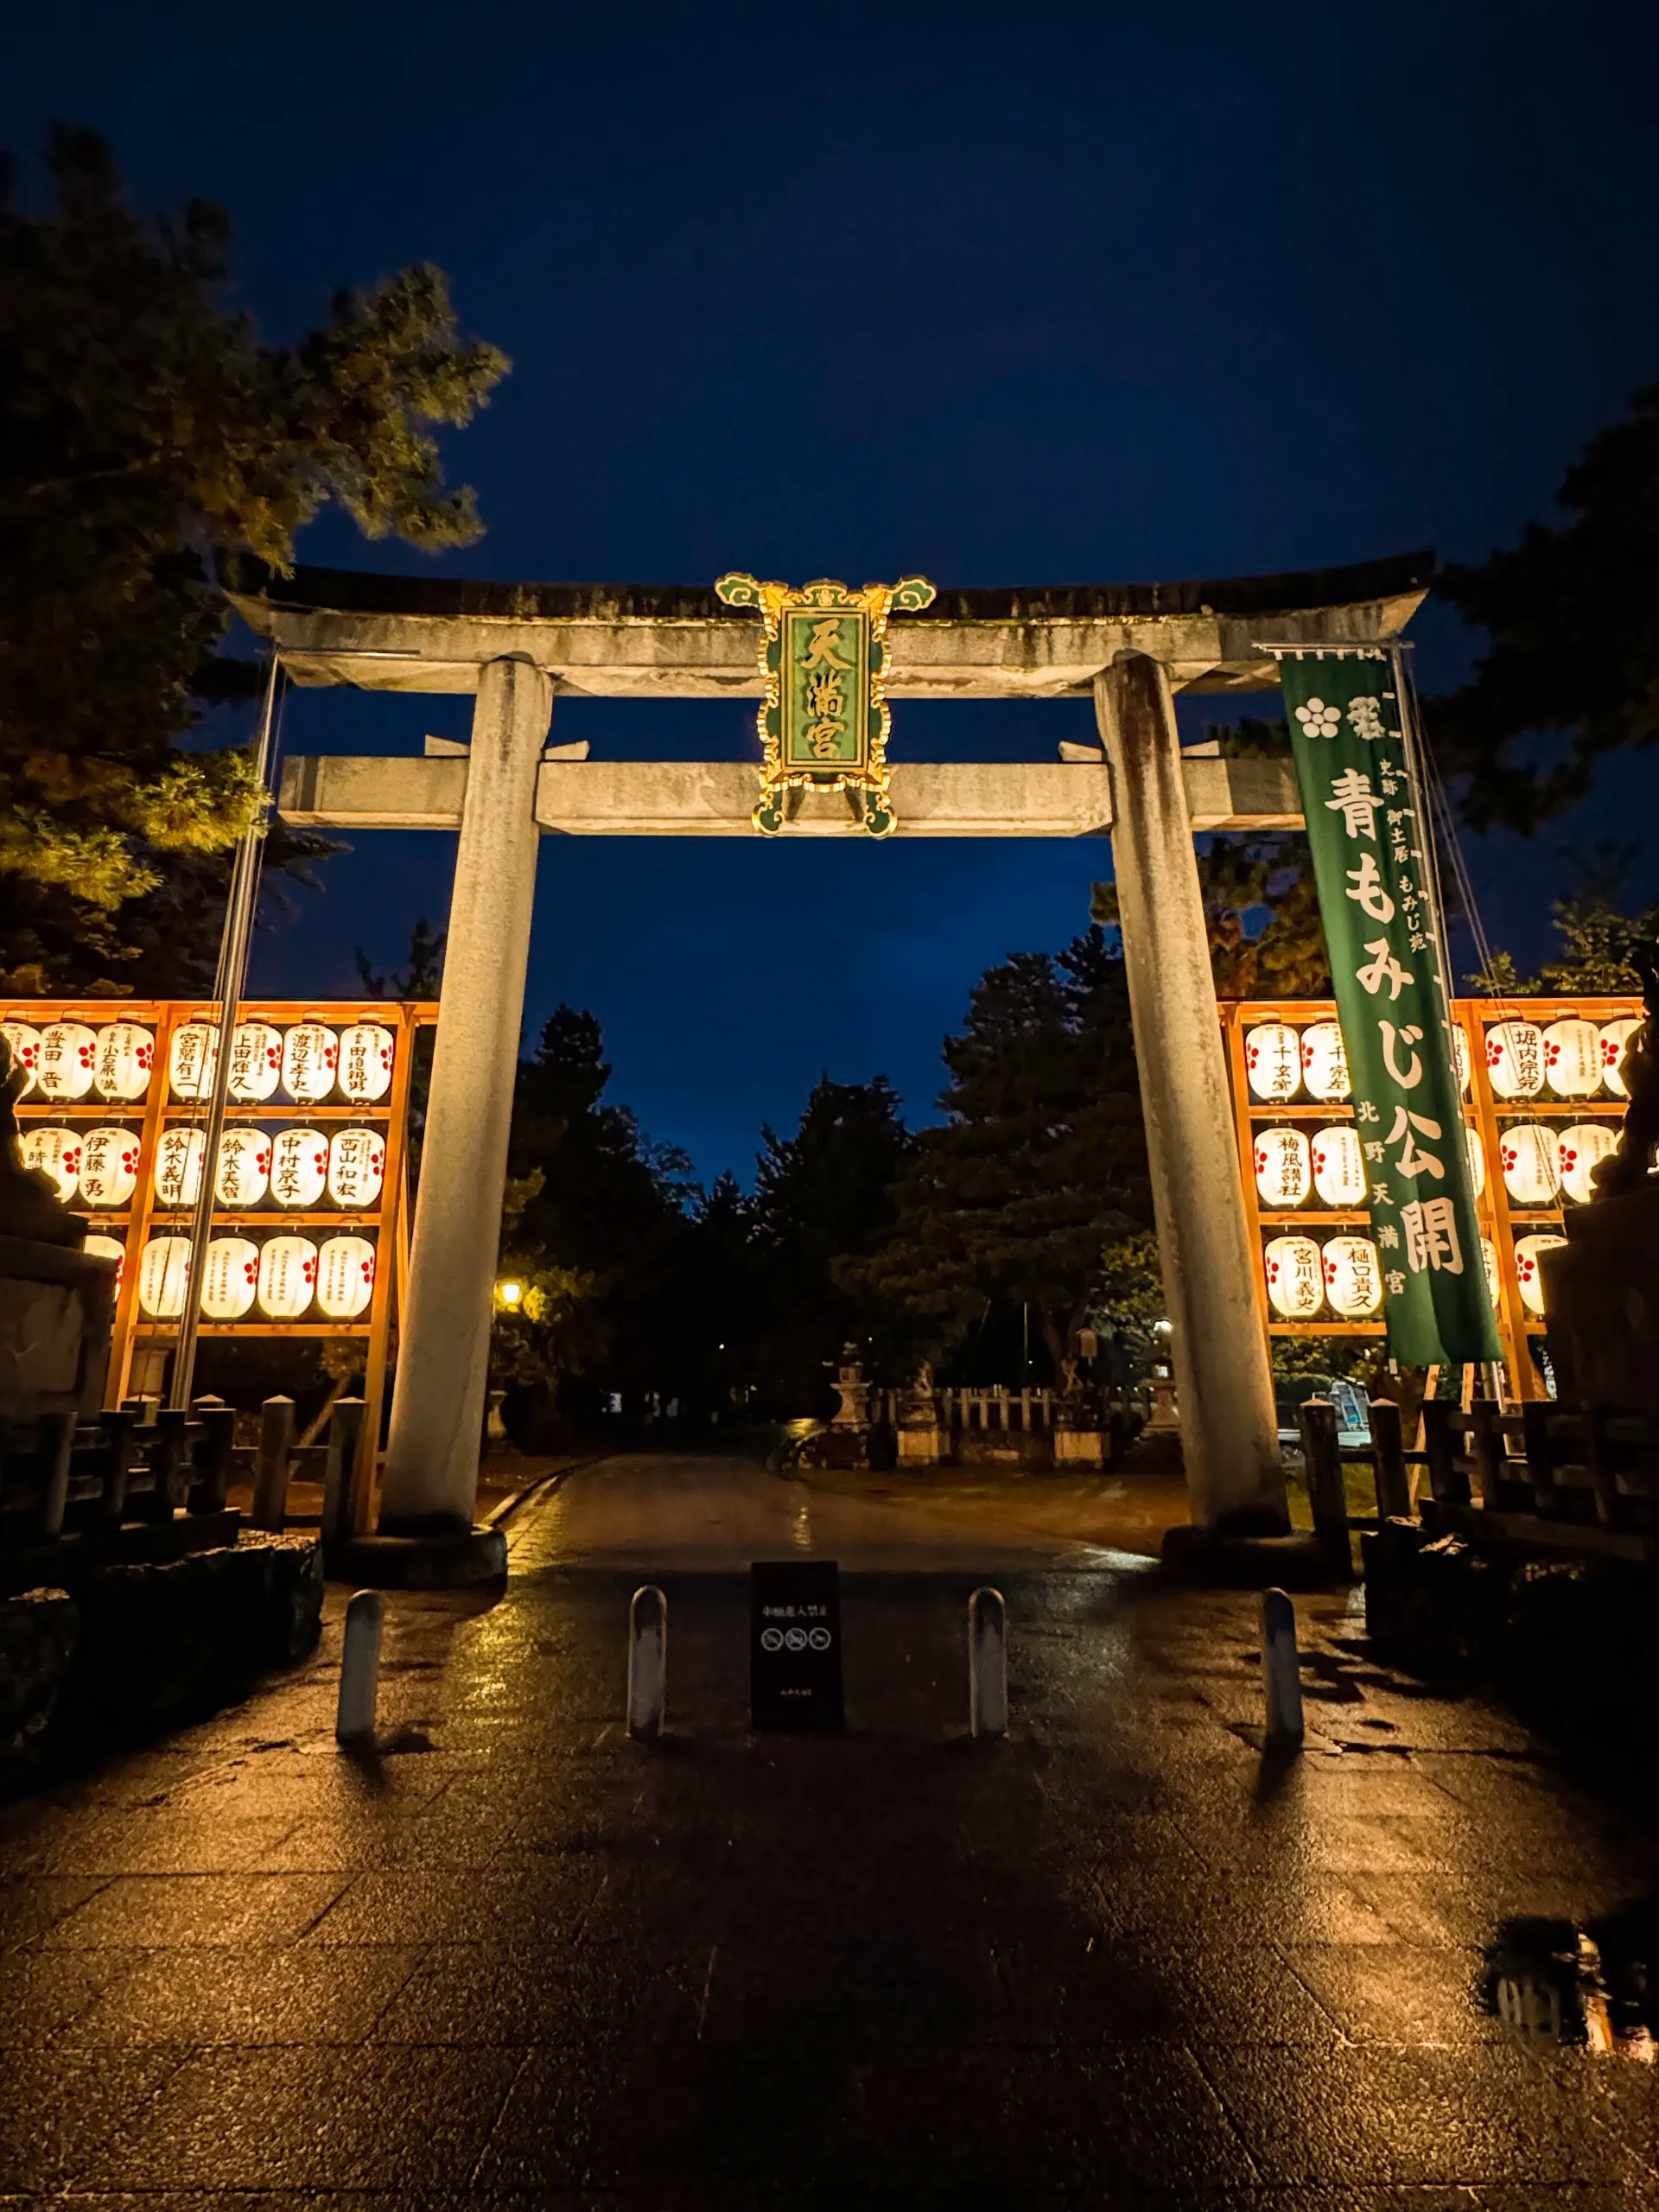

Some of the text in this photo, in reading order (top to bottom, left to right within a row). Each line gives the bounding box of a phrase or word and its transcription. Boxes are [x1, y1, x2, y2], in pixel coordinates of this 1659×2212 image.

[800, 619, 852, 759] 天満宮
[1324, 767, 1464, 1274] 青もみじ公開
[276, 1136, 301, 1198] 中村京子
[1357, 1101, 1407, 1295] 北野天満宮
